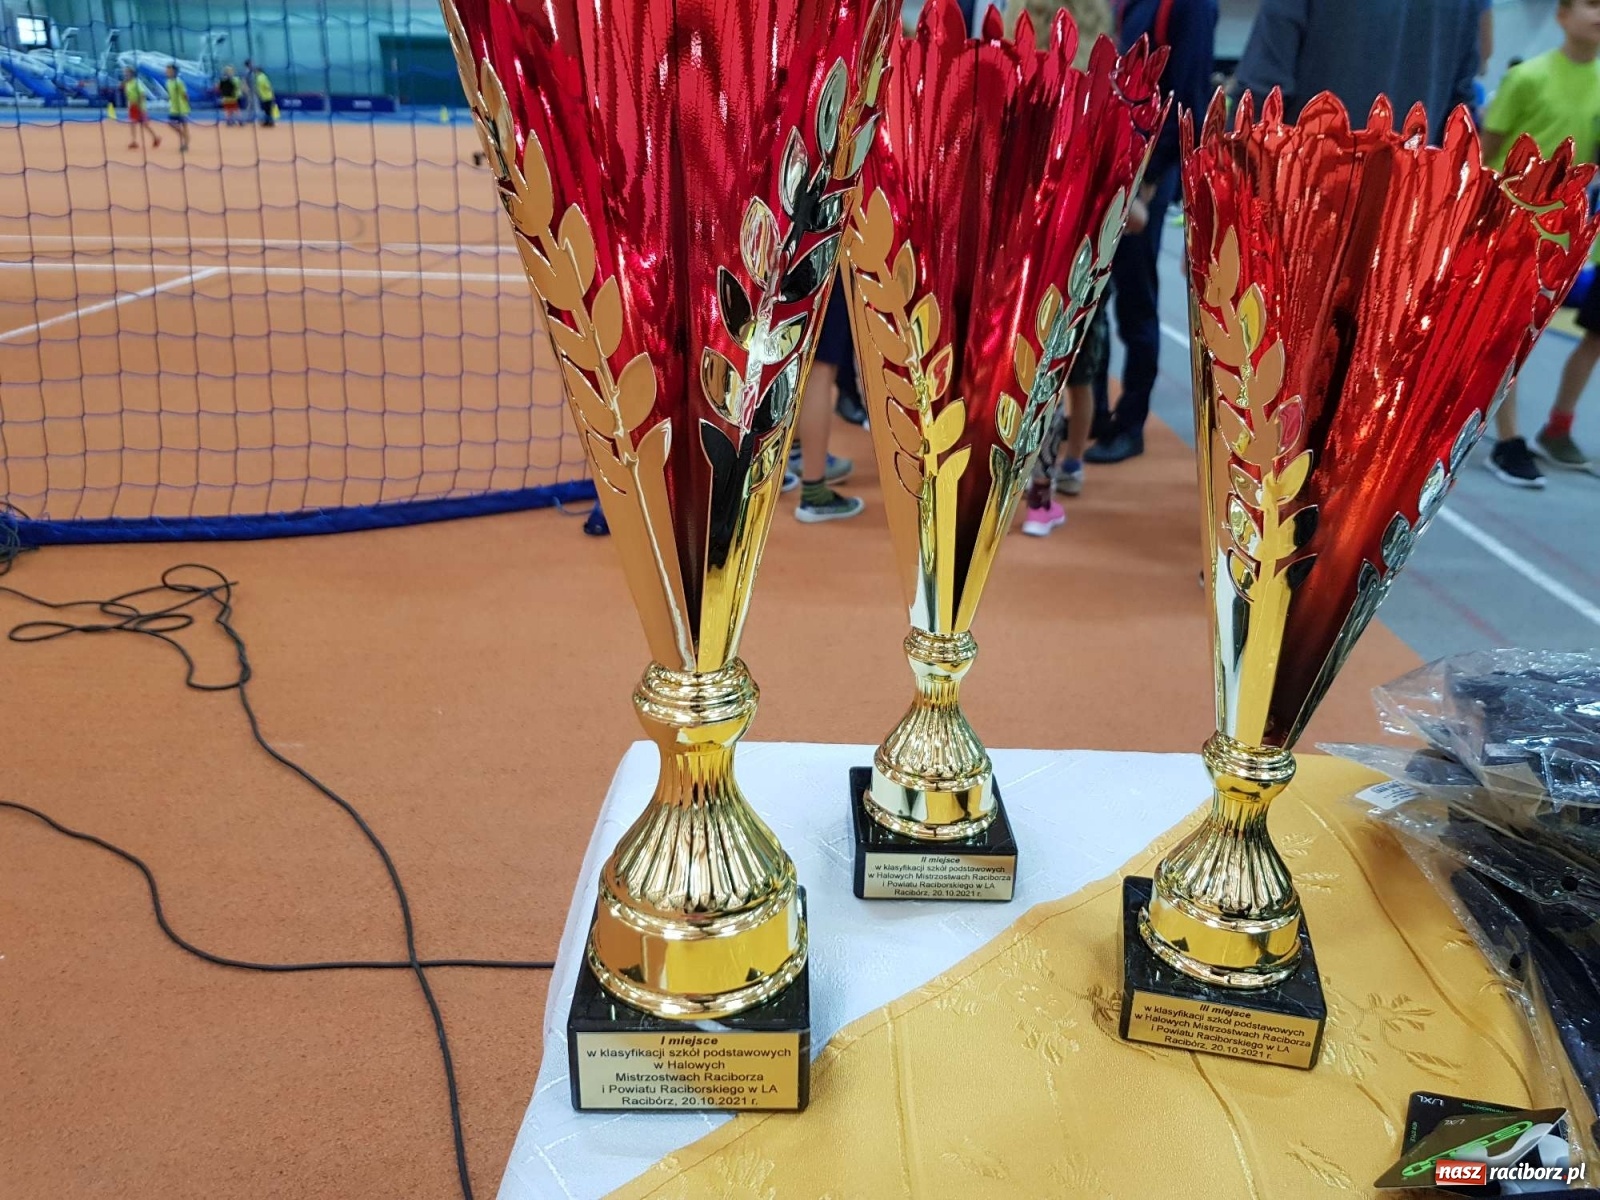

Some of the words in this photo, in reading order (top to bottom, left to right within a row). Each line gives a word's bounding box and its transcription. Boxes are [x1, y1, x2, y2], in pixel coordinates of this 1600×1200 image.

[1211, 1007, 1251, 1019] miejsce
[1154, 1006, 1205, 1021] klasyfikacji
[1207, 1015, 1232, 1026] szkół
[1234, 1020, 1304, 1037] podstawowych
[1145, 1013, 1190, 1028] Halowych
[1193, 1022, 1259, 1039] Mistrzostwach
[1263, 1033, 1311, 1048] Raciborza
[669, 1036, 718, 1046] miejsce
[1157, 1026, 1194, 1038] Powiatu
[1197, 1032, 1263, 1050] Raciborskiego
[600, 1049, 665, 1058] klasyfikacji
[669, 1048, 700, 1057] szkół
[704, 1048, 791, 1059] podstawowych
[1211, 1044, 1263, 1058] 20.10.2021
[668, 1060, 724, 1070] Halowych
[616, 1073, 700, 1081] Mistrzostwach
[704, 1072, 764, 1081] Raciborza
[609, 1085, 656, 1094] Powiatu
[660, 1085, 744, 1095] Raciborskiego
[762, 1085, 777, 1093] LA
[622, 1096, 677, 1106] Racibórz,
[682, 1097, 746, 1105] 20.10.2021
[1417, 1095, 1444, 1106] L/XL
